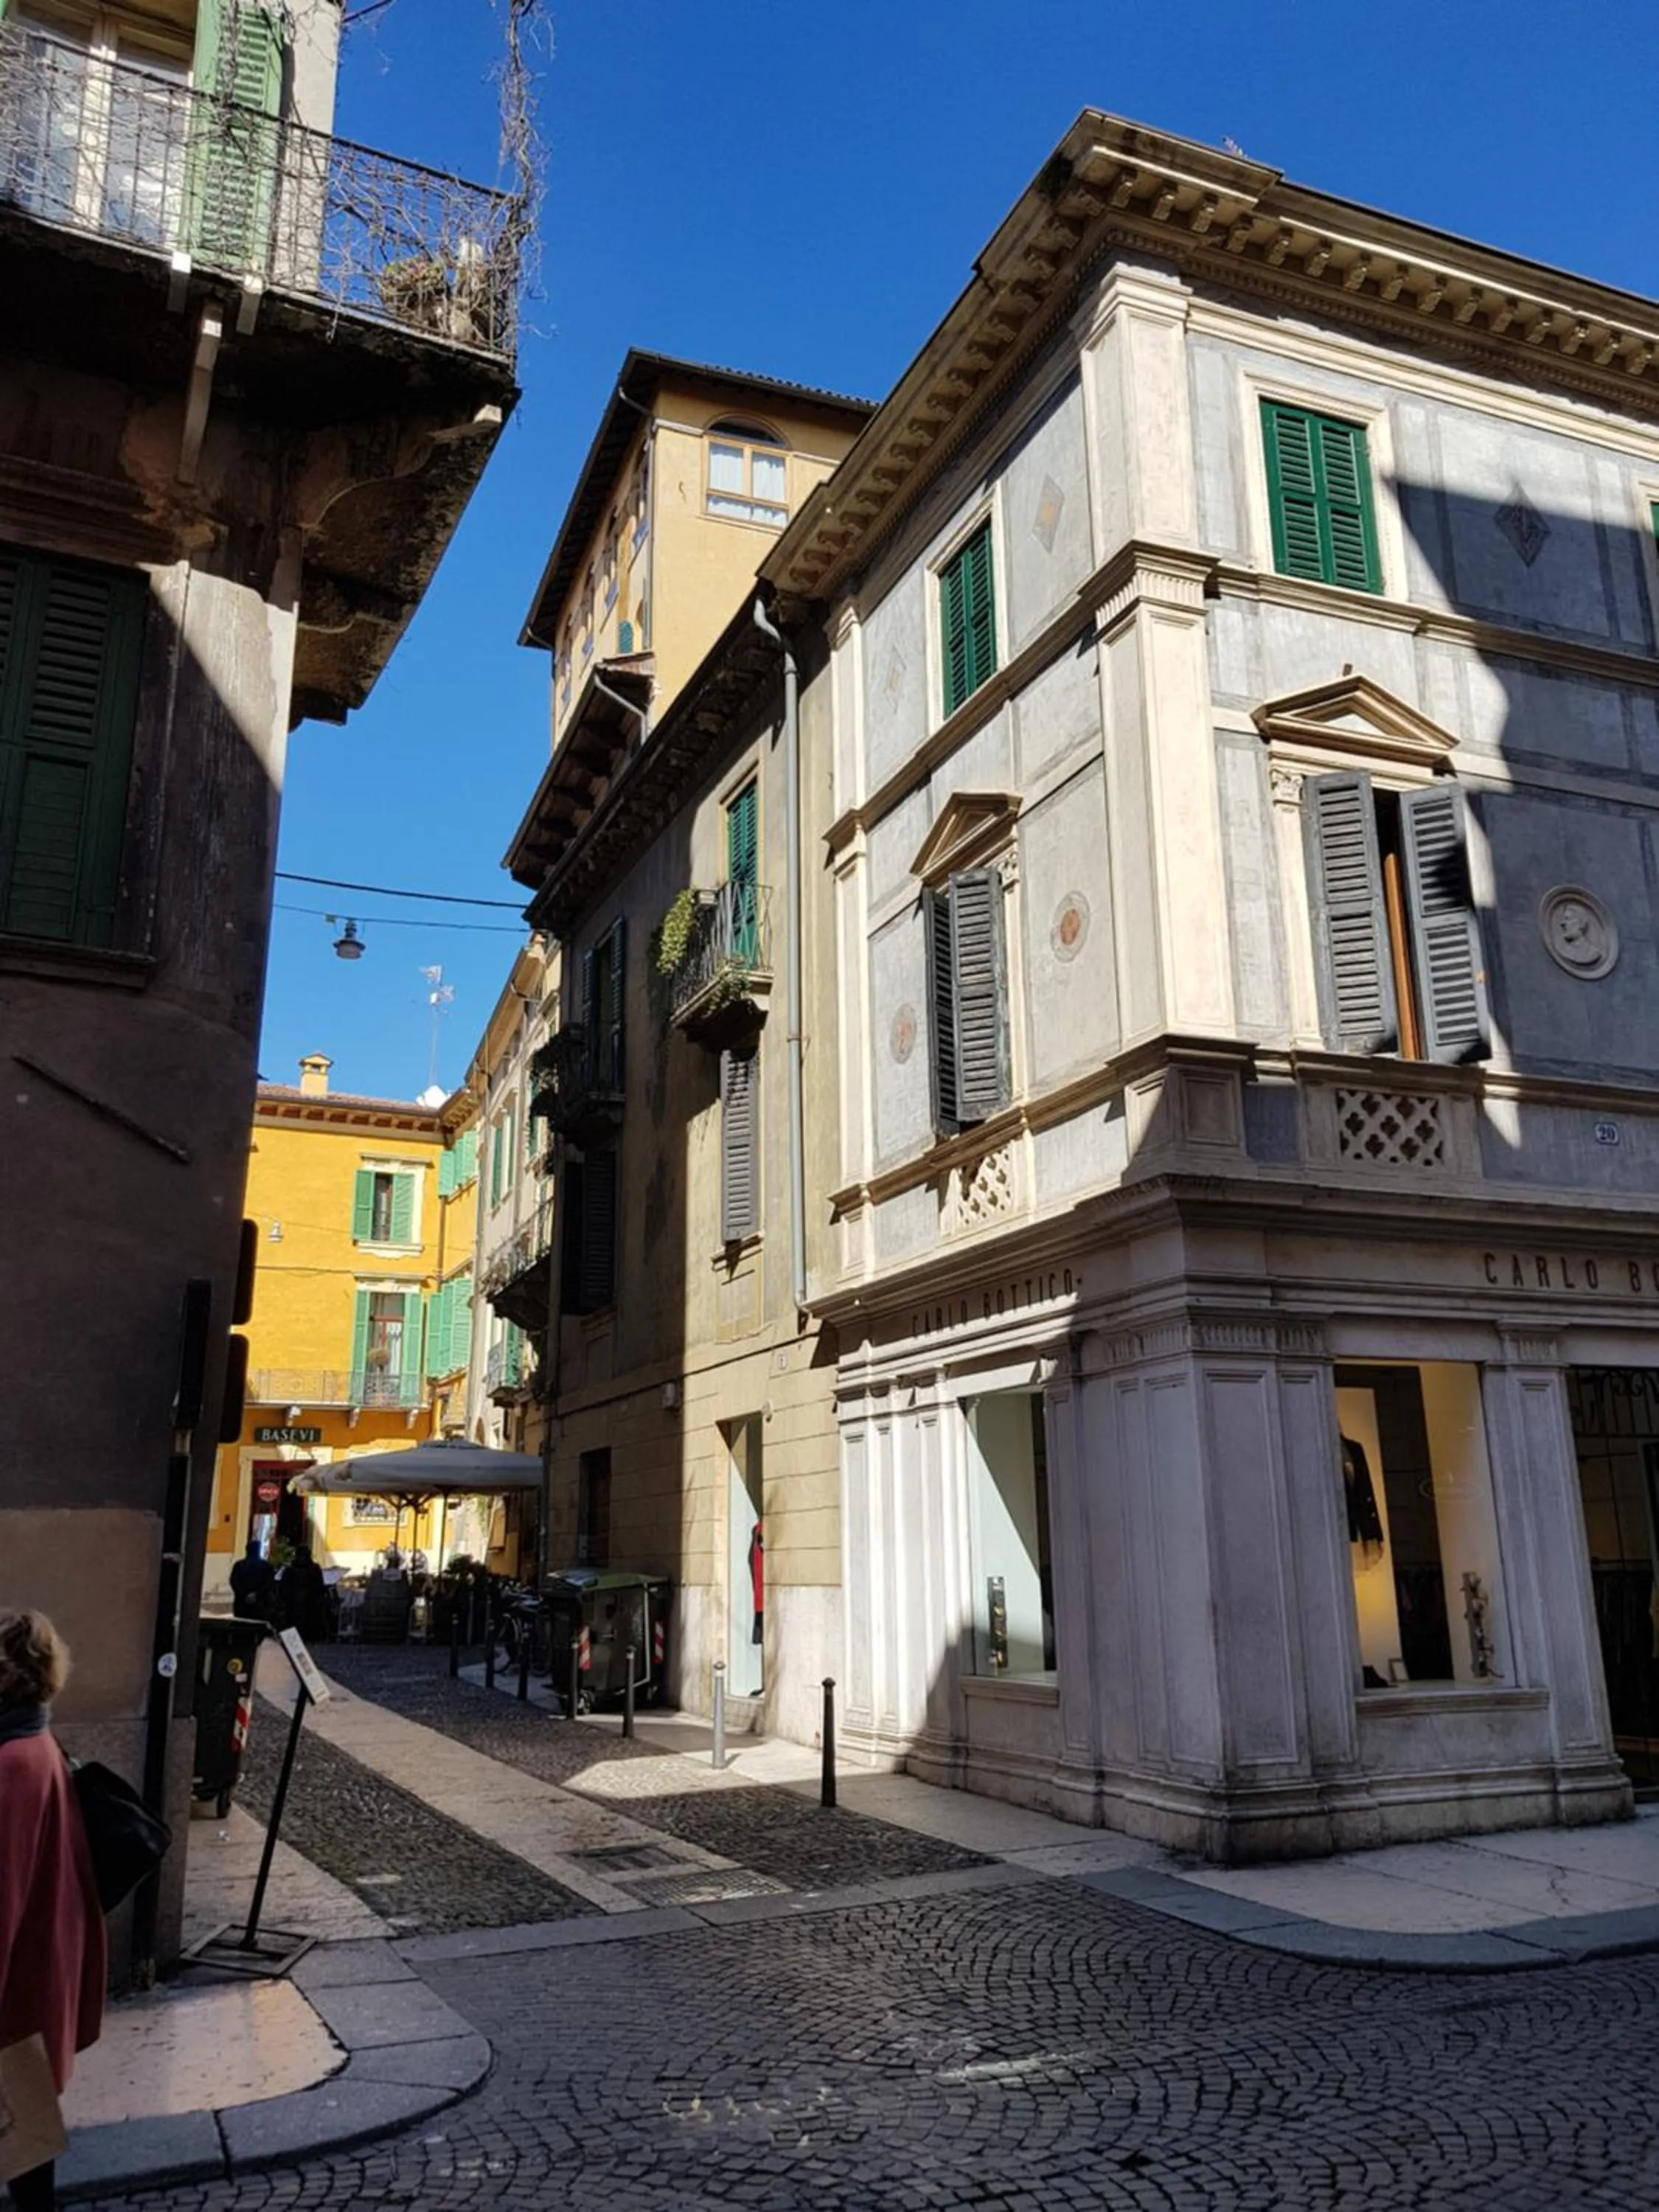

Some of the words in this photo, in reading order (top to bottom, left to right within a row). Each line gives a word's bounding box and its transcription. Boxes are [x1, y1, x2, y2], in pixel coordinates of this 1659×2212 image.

[1598, 1126, 1615, 1141] 20
[1484, 1252, 1599, 1290] CARLO
[912, 1298, 967, 1337] CARLO
[262, 1427, 315, 1441] BASEVI
